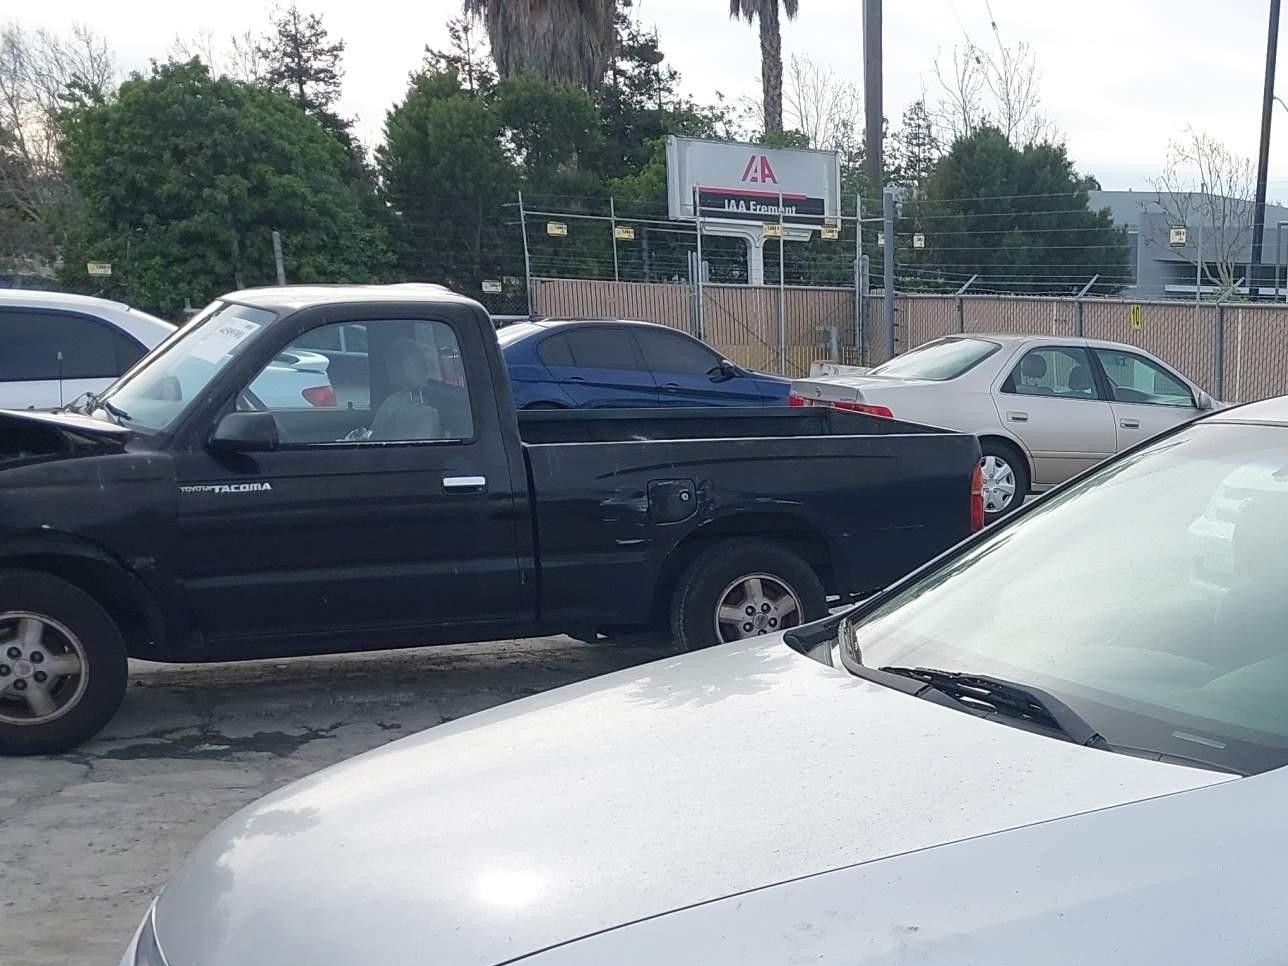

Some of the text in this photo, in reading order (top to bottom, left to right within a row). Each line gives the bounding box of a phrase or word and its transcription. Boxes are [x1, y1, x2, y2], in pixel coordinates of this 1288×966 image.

[724, 199, 797, 216] IAA Fremont
[1132, 305, 1140, 326] 10
[213, 482, 272, 493] TACOMA
